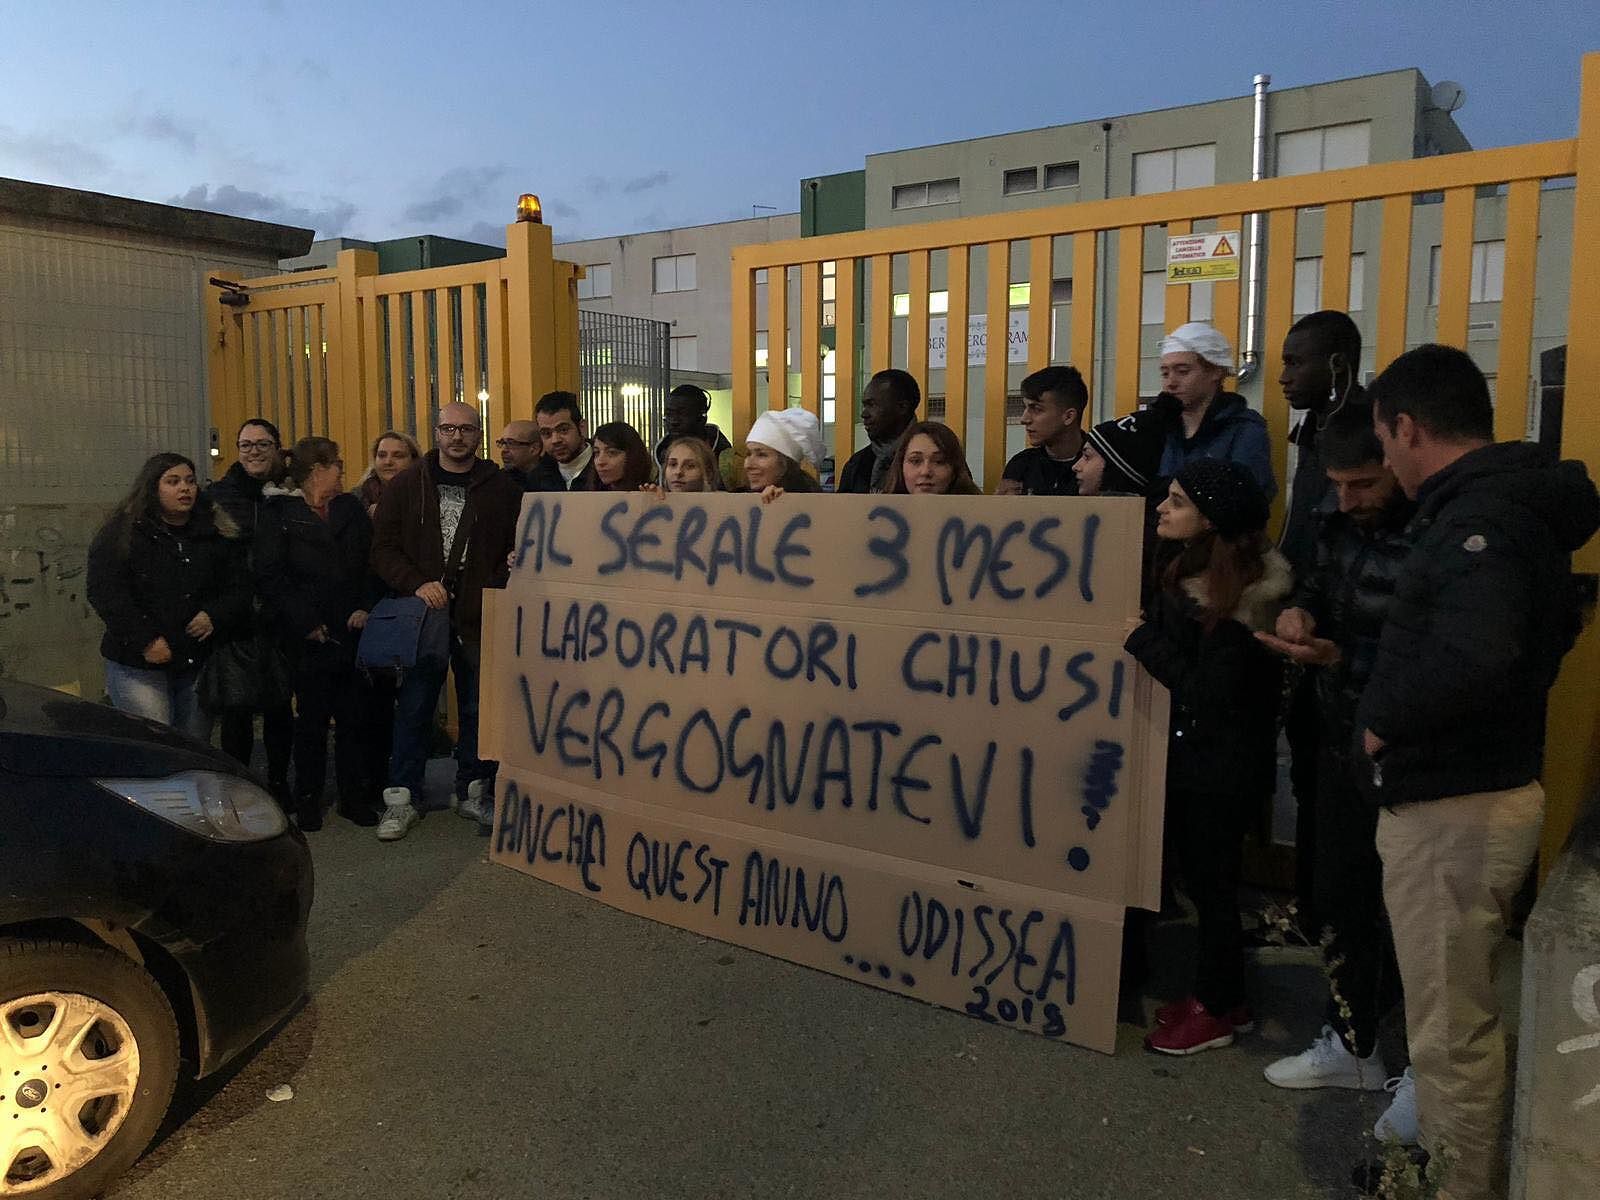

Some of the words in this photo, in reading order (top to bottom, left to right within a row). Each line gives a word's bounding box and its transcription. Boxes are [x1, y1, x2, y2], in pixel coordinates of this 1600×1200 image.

[515, 498, 574, 575] AL
[597, 500, 816, 588] SERALE
[854, 505, 911, 599] 3
[936, 514, 1102, 606] MESI
[515, 604, 523, 658] I
[540, 600, 858, 691] LABORATORI
[901, 631, 1126, 721] CHIUSI
[898, 890, 1077, 1006] ODISSEA
